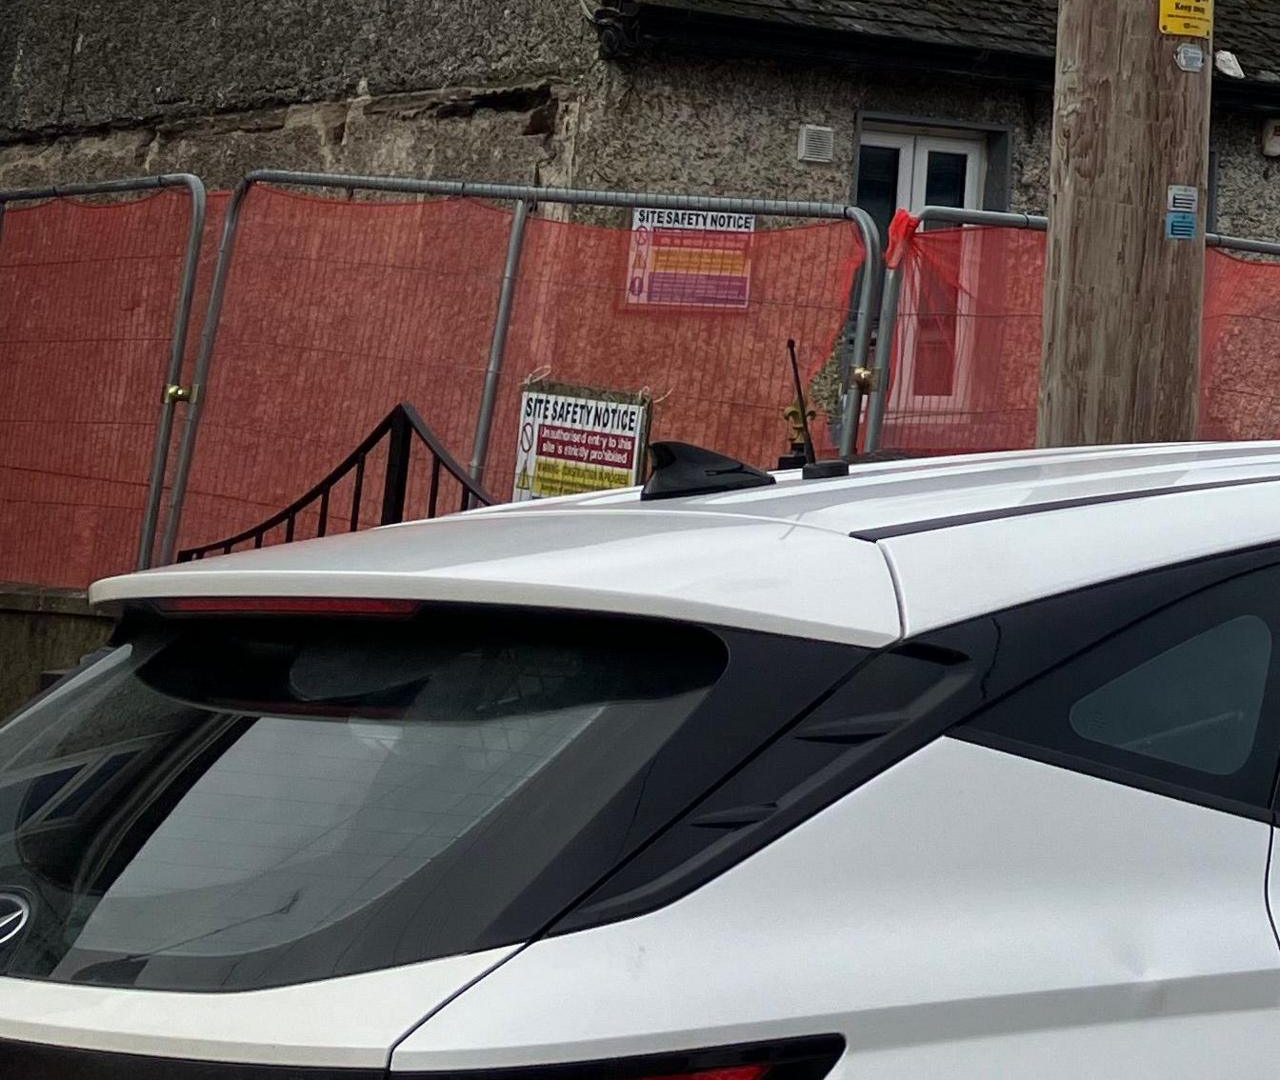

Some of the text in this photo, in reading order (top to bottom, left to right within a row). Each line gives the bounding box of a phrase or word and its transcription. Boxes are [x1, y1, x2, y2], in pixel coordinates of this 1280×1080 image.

[638, 209, 752, 229] SITE SAFETY NOTICE
[526, 397, 636, 431] SITE SAFETY NOTICE
[608, 436, 617, 447] to
